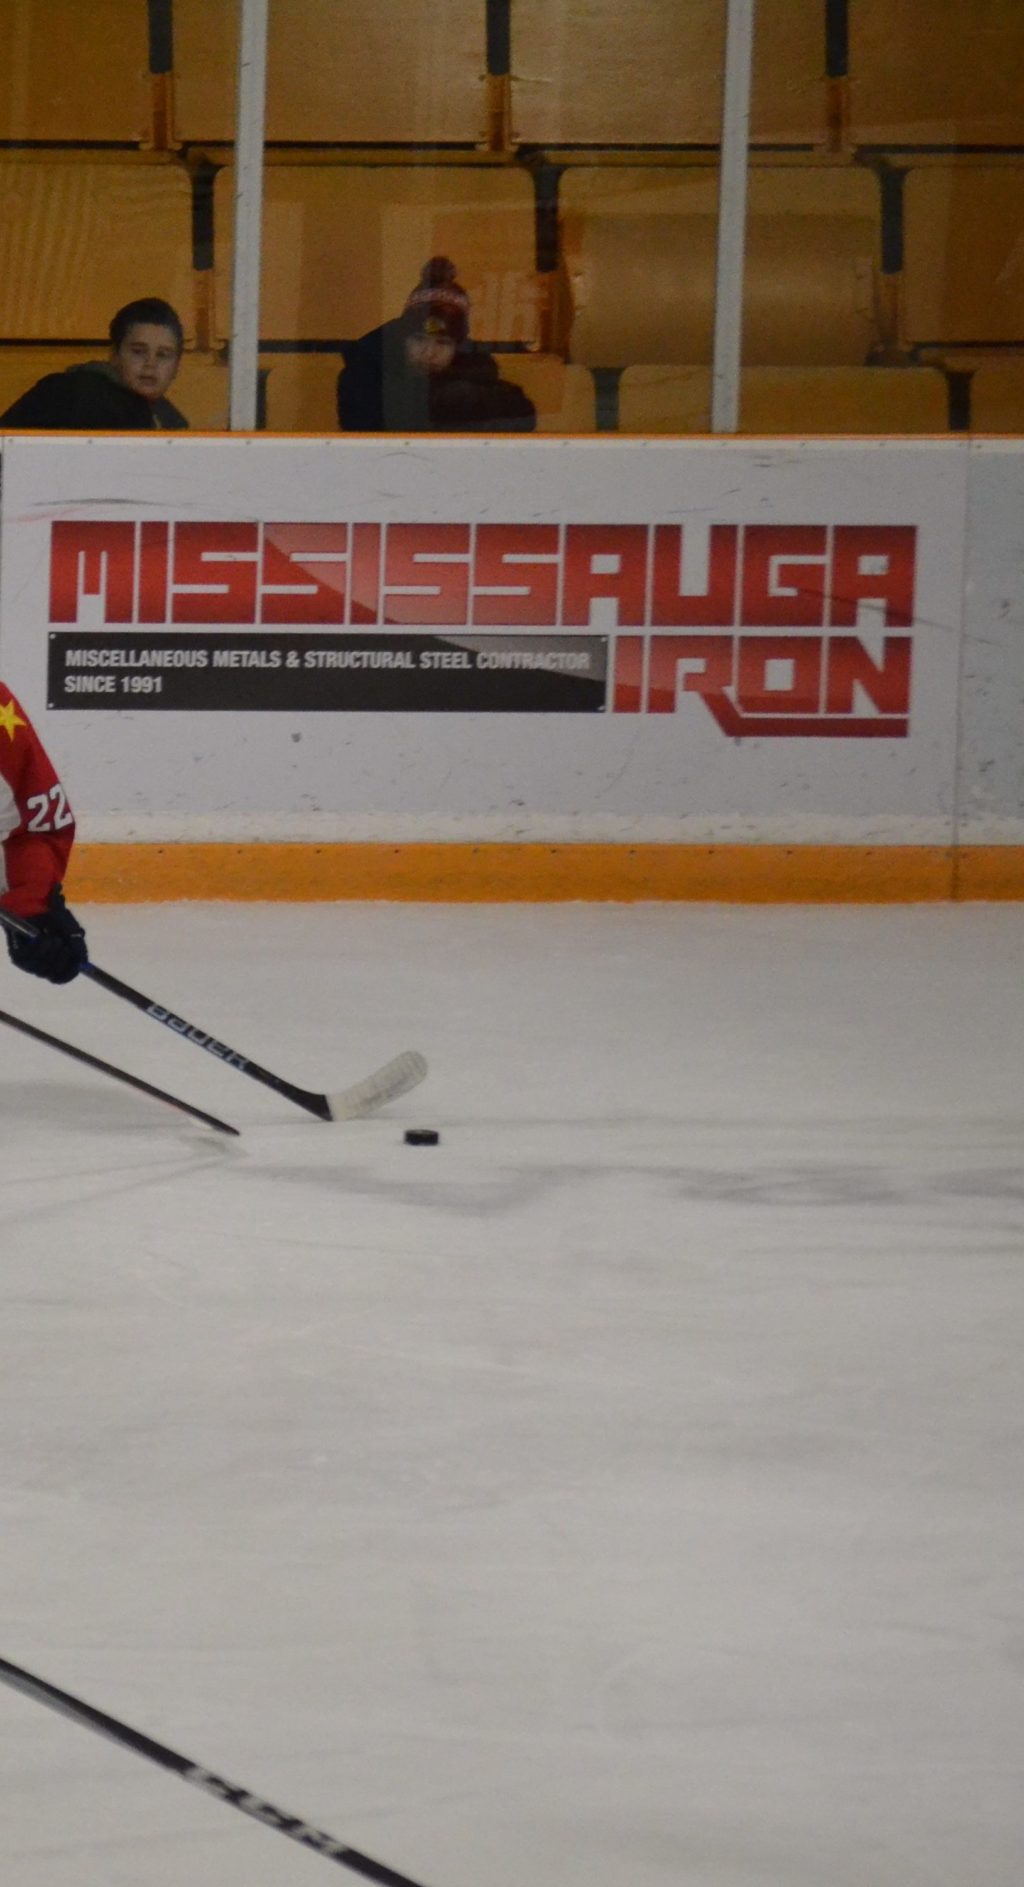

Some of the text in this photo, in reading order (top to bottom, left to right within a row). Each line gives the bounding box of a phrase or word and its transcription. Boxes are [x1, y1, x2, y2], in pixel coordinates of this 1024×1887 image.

[48, 520, 918, 628] MISSISSAUGA
[65, 649, 591, 670] MISCELLANEOUS METALS & STRUCTURAL STEEL CONTRACTOR
[64, 675, 163, 693] SINCE 1991
[612, 635, 914, 737] IRON
[26, 784, 74, 832] 22
